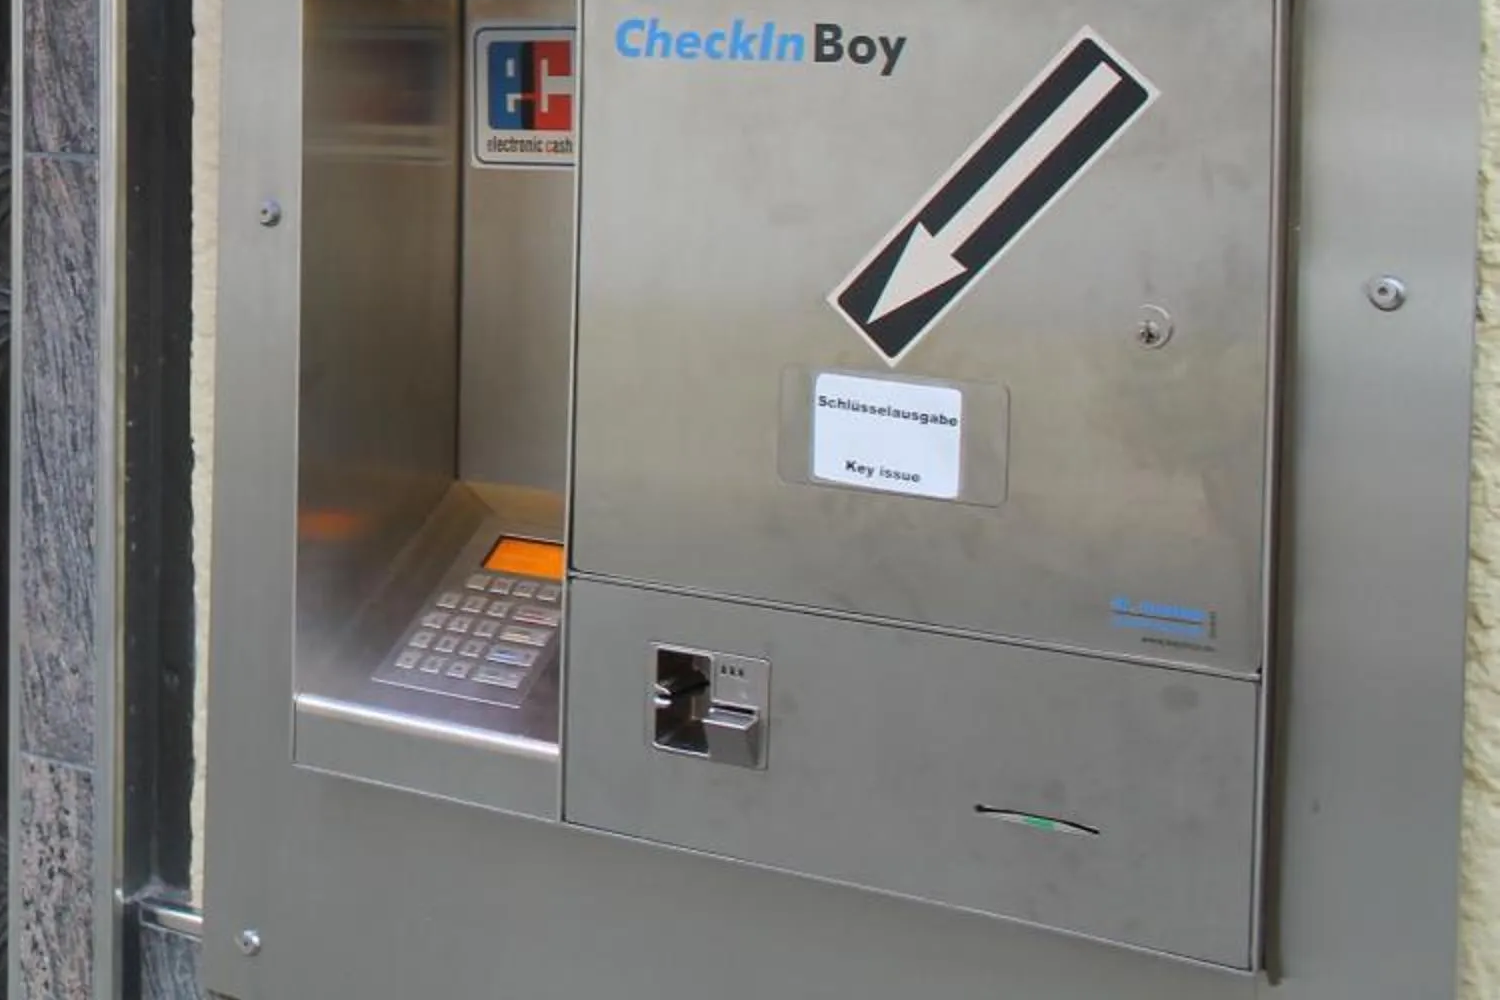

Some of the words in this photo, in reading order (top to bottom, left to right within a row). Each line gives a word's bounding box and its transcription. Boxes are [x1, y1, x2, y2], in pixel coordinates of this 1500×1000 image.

[813, 23, 907, 76] Boy
[487, 135, 542, 153] electronic
[545, 137, 573, 153] cash
[817, 394, 958, 428] Schlüsselausgabe
[844, 459, 875, 478] Key
[879, 465, 922, 484] issue
